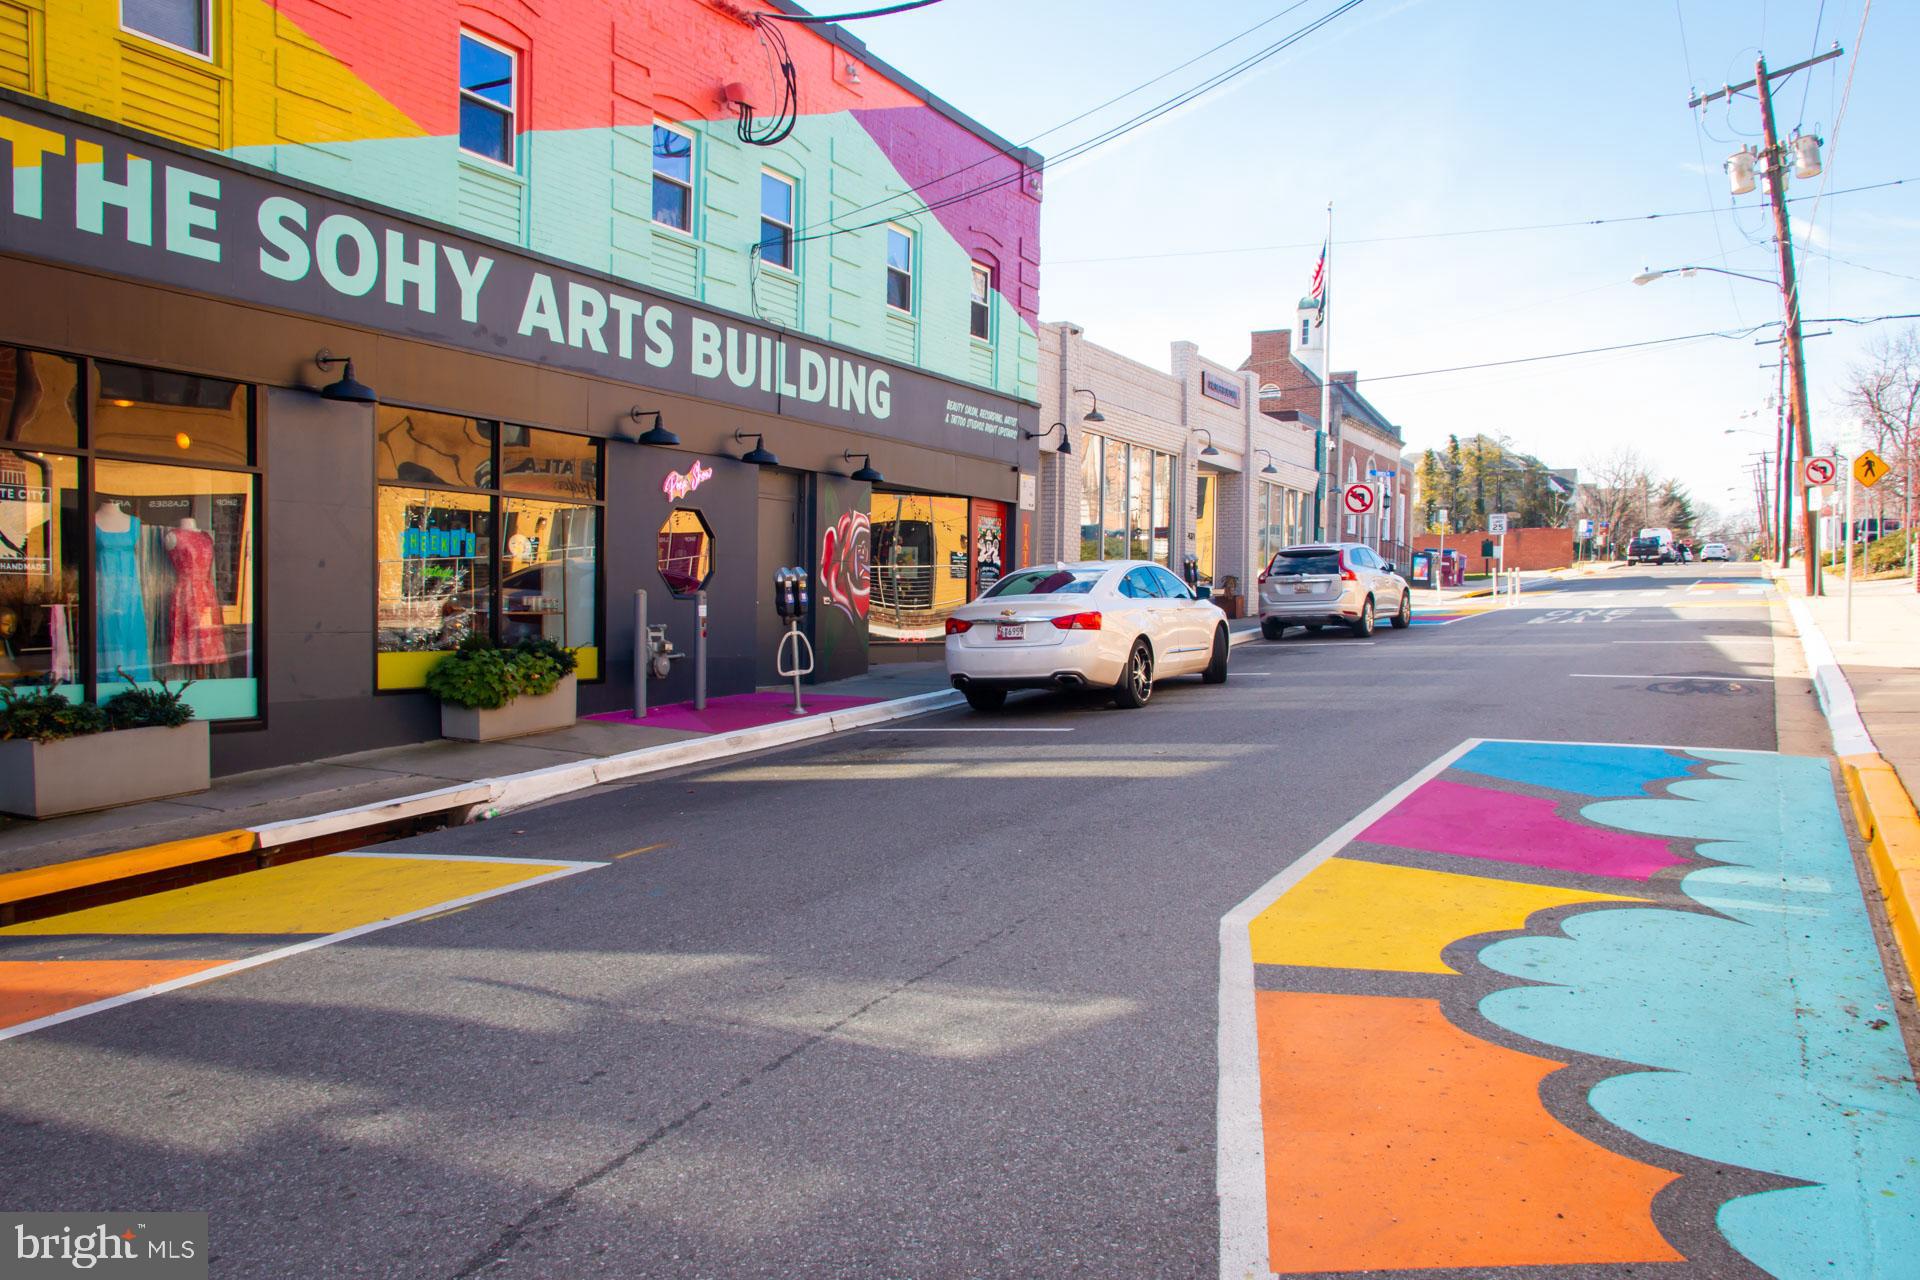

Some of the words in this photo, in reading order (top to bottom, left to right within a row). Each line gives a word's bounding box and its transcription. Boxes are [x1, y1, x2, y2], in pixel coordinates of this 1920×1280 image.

[0, 115, 222, 263] THE
[258, 196, 495, 323] SOHY
[517, 272, 674, 368] ARTS
[691, 317, 891, 420] BUILDING
[946, 399, 965, 413] BEAUTY
[950, 414, 966, 427] TATTOO
[17, 490, 46, 501] CITY
[1526, 616, 1623, 624] WAY
